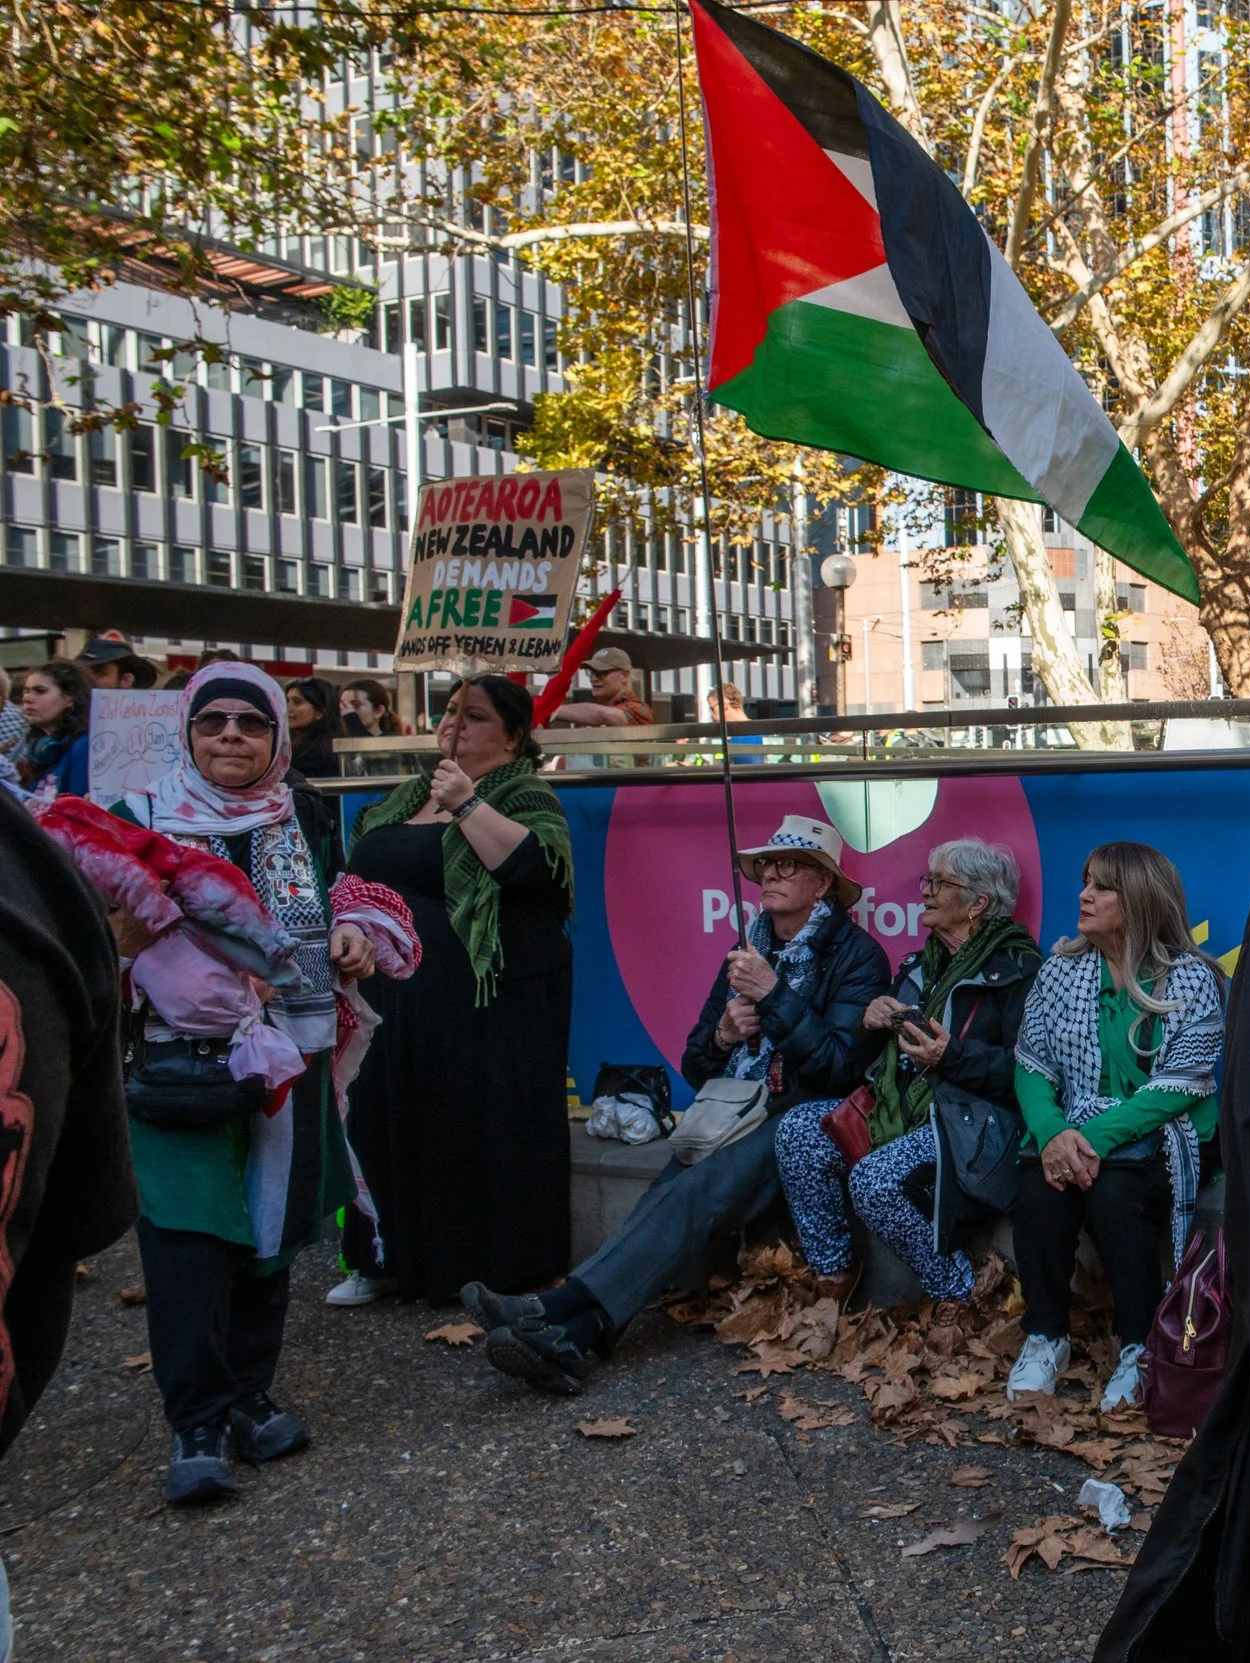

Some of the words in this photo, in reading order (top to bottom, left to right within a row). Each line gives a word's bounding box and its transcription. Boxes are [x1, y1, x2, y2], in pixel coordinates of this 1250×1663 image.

[418, 477, 563, 530] AOTEAROA
[414, 525, 452, 565] NEW
[450, 523, 575, 560] ZEALAND
[432, 559, 553, 593] DEMANDS
[405, 594, 424, 632] A
[425, 587, 504, 630] FREE
[427, 635, 453, 656] OFF
[454, 633, 506, 658] YEMEN
[509, 638, 518, 654] &
